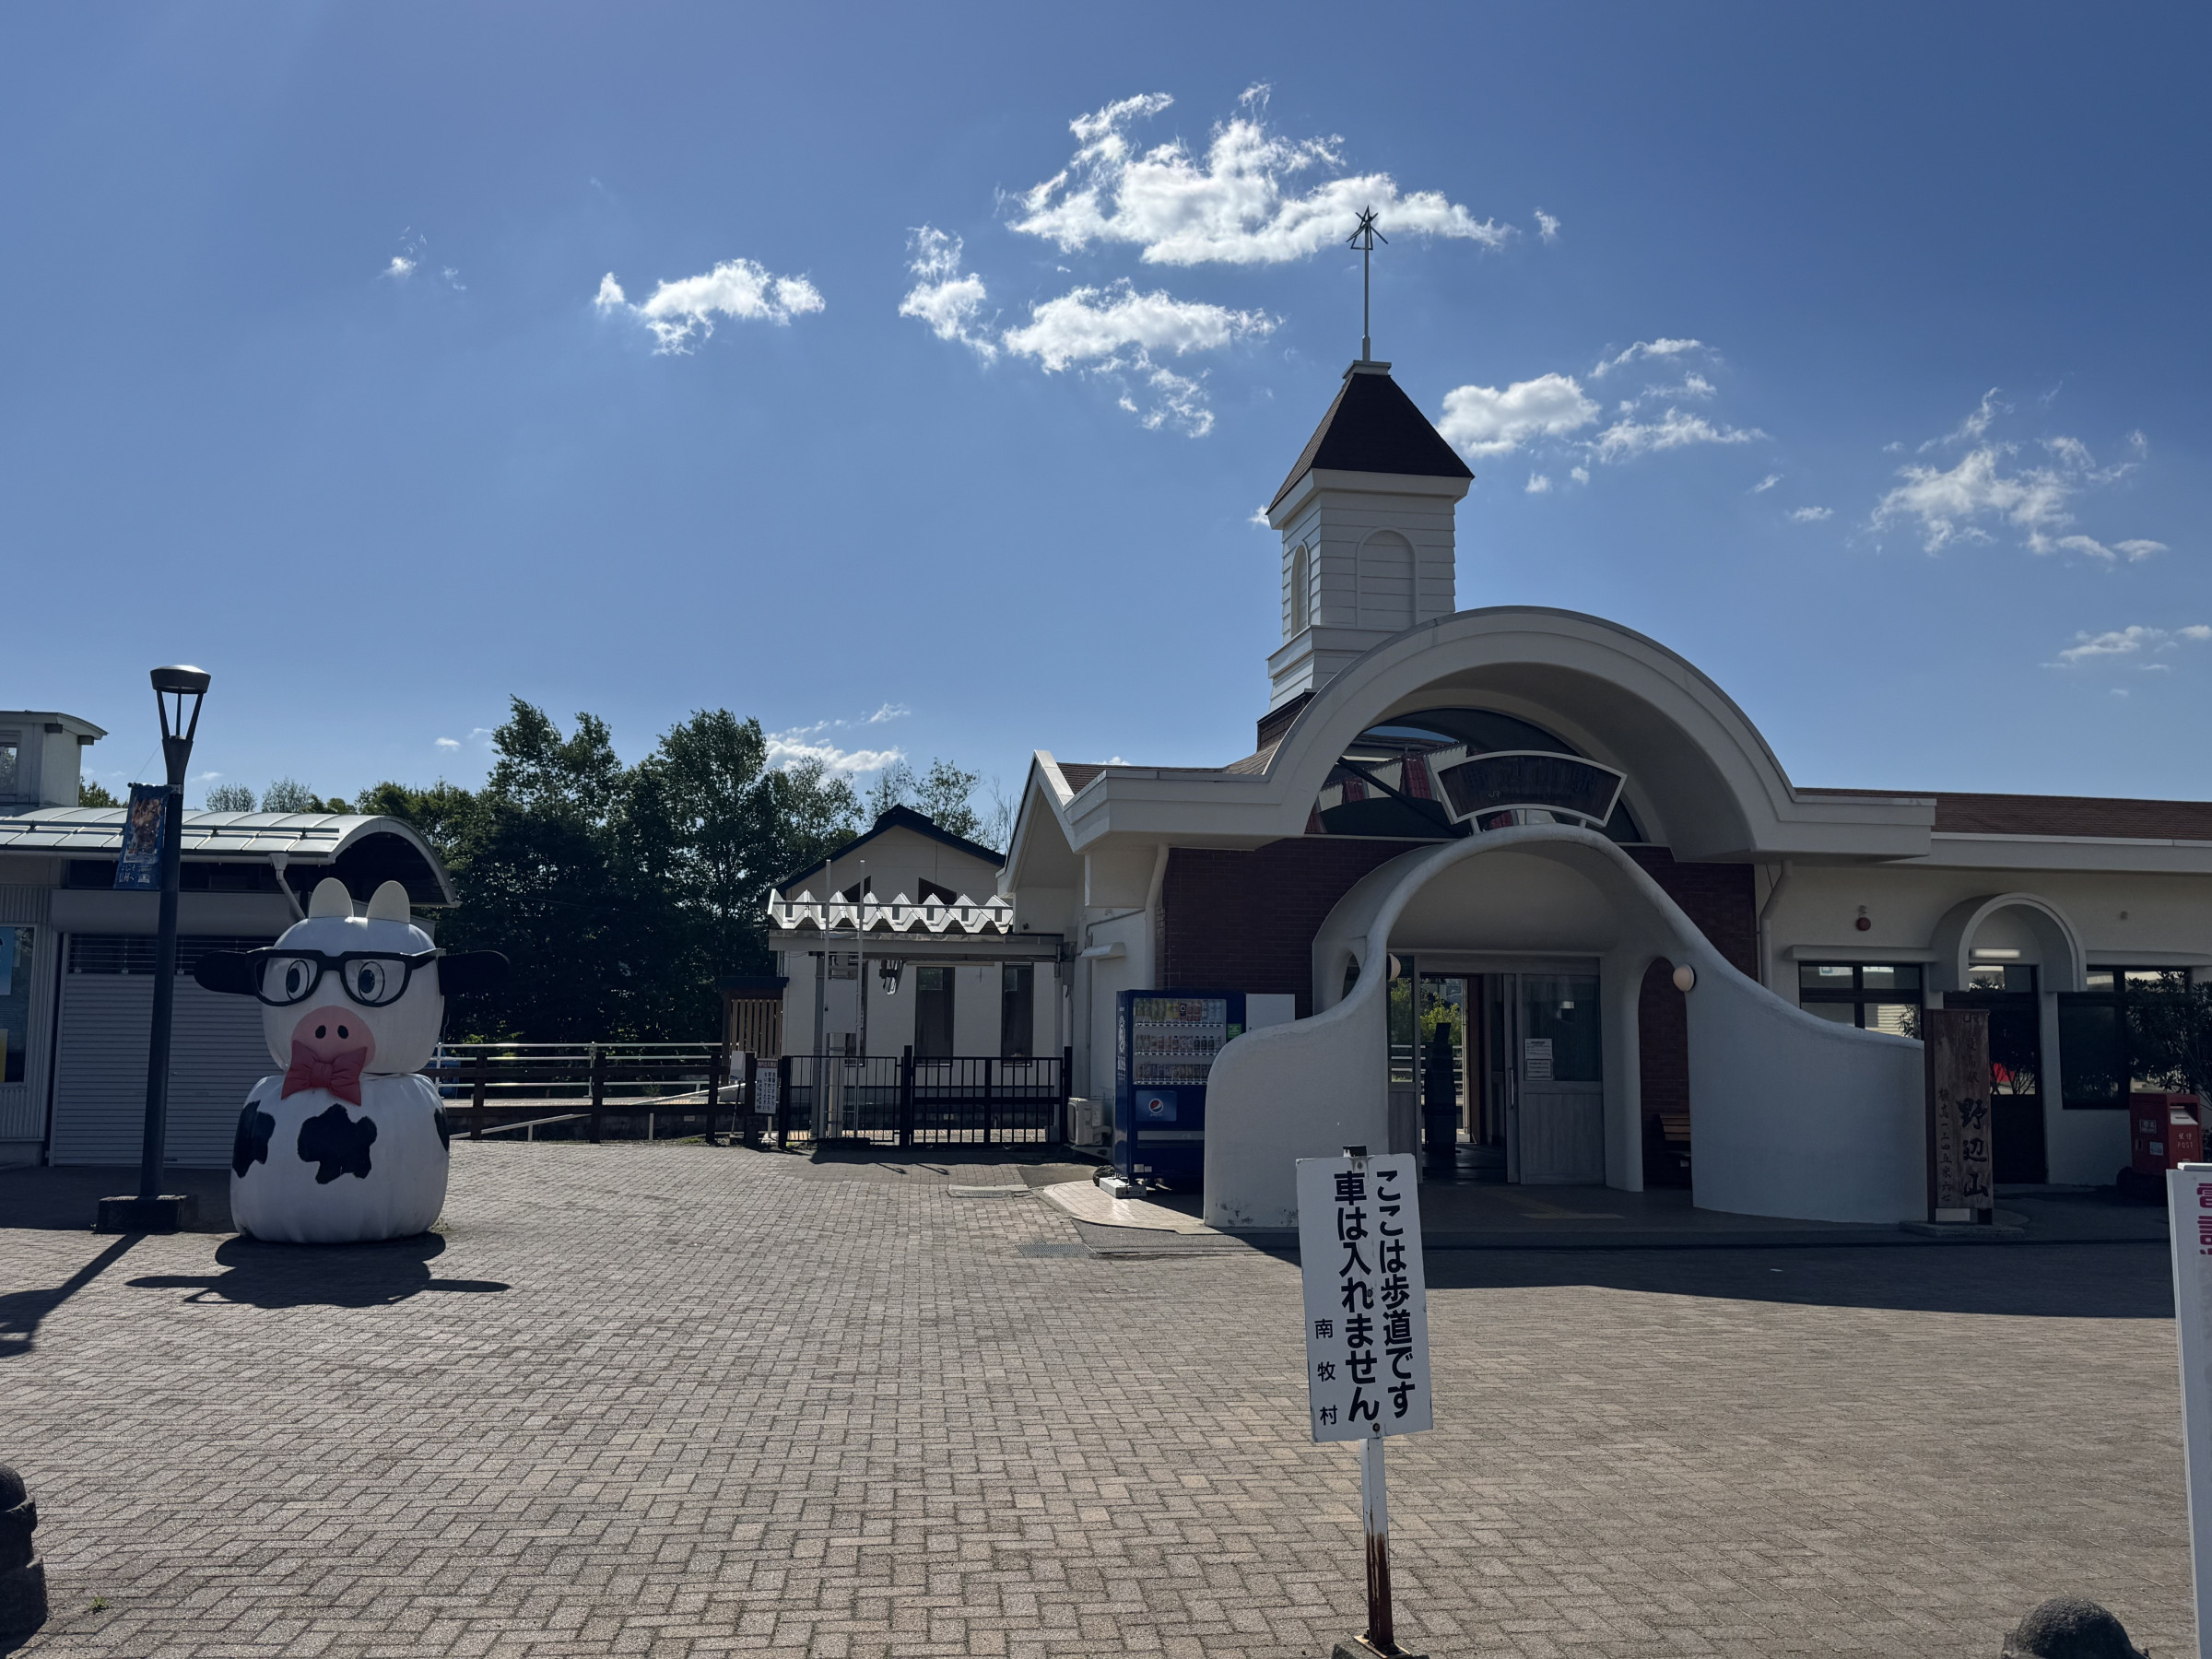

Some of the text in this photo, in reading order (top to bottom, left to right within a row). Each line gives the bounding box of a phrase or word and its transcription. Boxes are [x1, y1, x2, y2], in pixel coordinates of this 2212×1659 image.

[1488, 790, 1500, 798] JR
[1956, 1097, 1989, 1198] 野辺山
[1376, 1170, 1416, 1418] ここは歩道です
[1313, 1318, 1338, 1426] 南牧村
